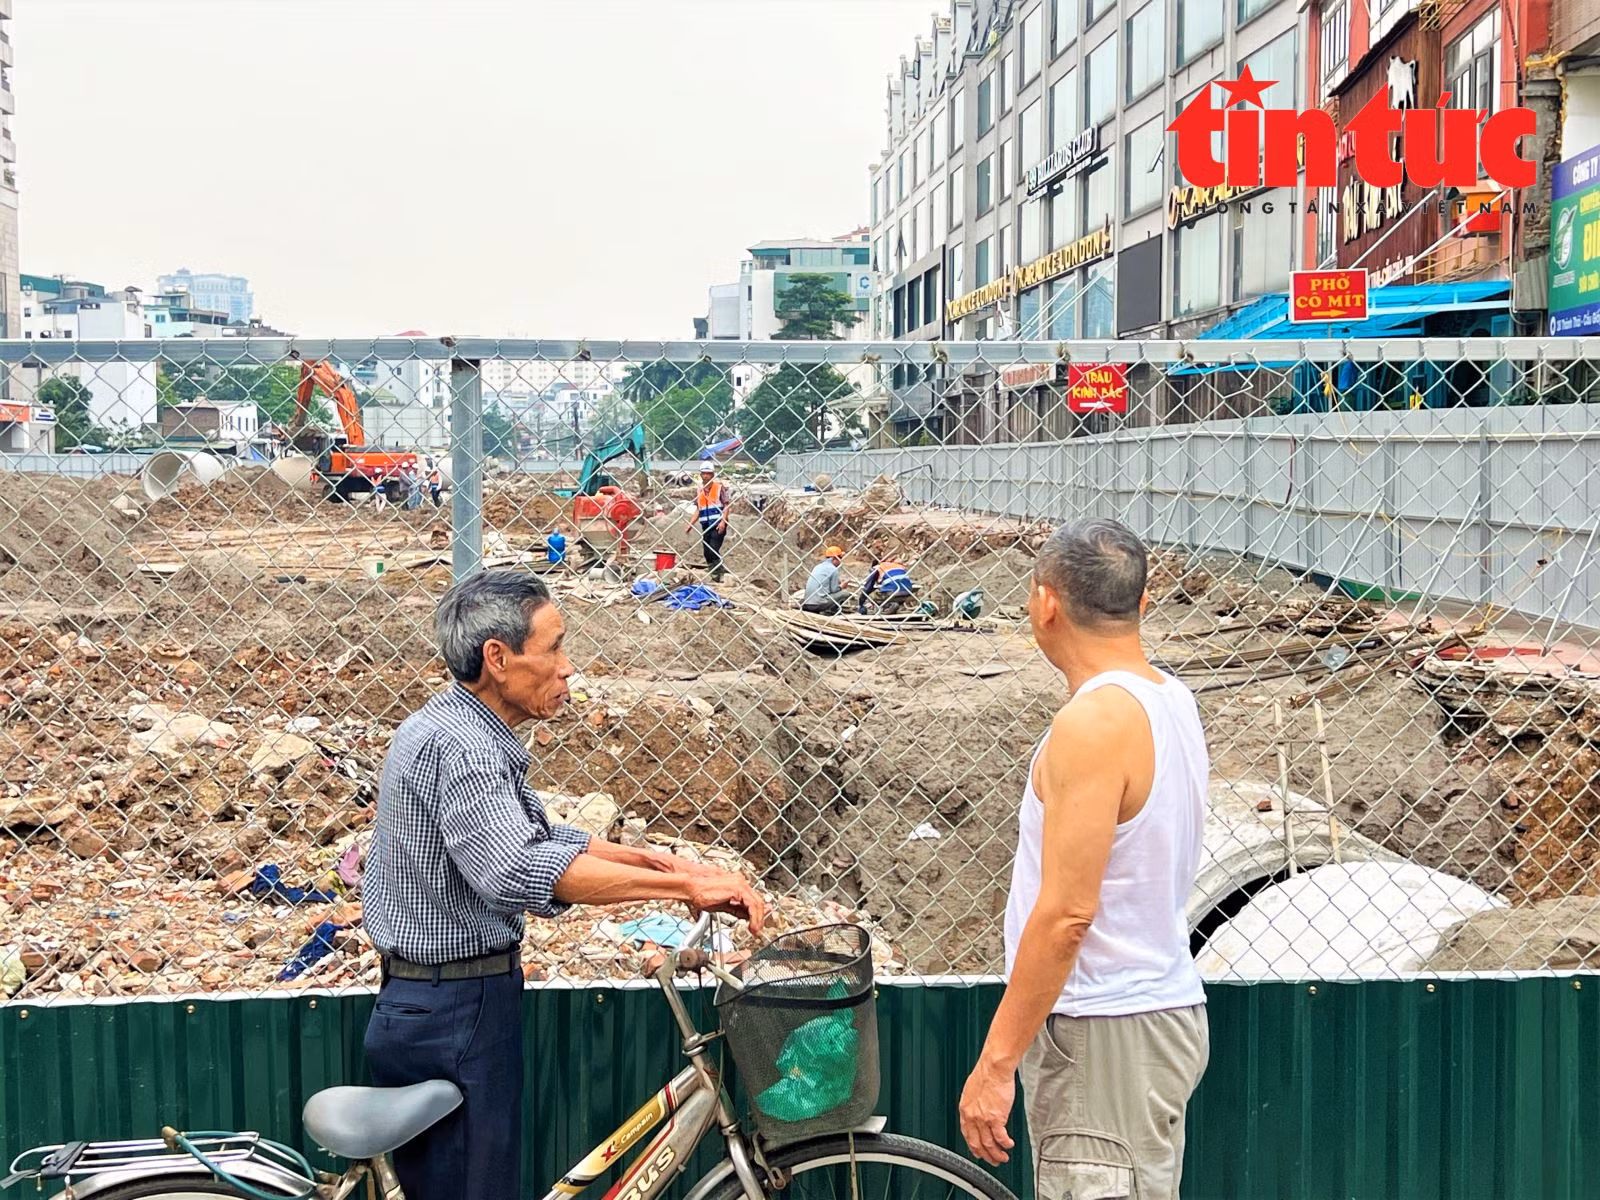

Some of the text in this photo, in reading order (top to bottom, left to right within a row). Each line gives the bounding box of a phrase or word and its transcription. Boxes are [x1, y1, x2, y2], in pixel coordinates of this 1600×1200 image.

[1073, 126, 1093, 161] CLUB
[1017, 231, 1102, 289] KARAOKE LONDON
[1310, 272, 1351, 291] PHỞ
[1295, 290, 1364, 308] CÔ MÍT
[1072, 386, 1097, 399] KINH
[620, 1112, 653, 1144] Campain
